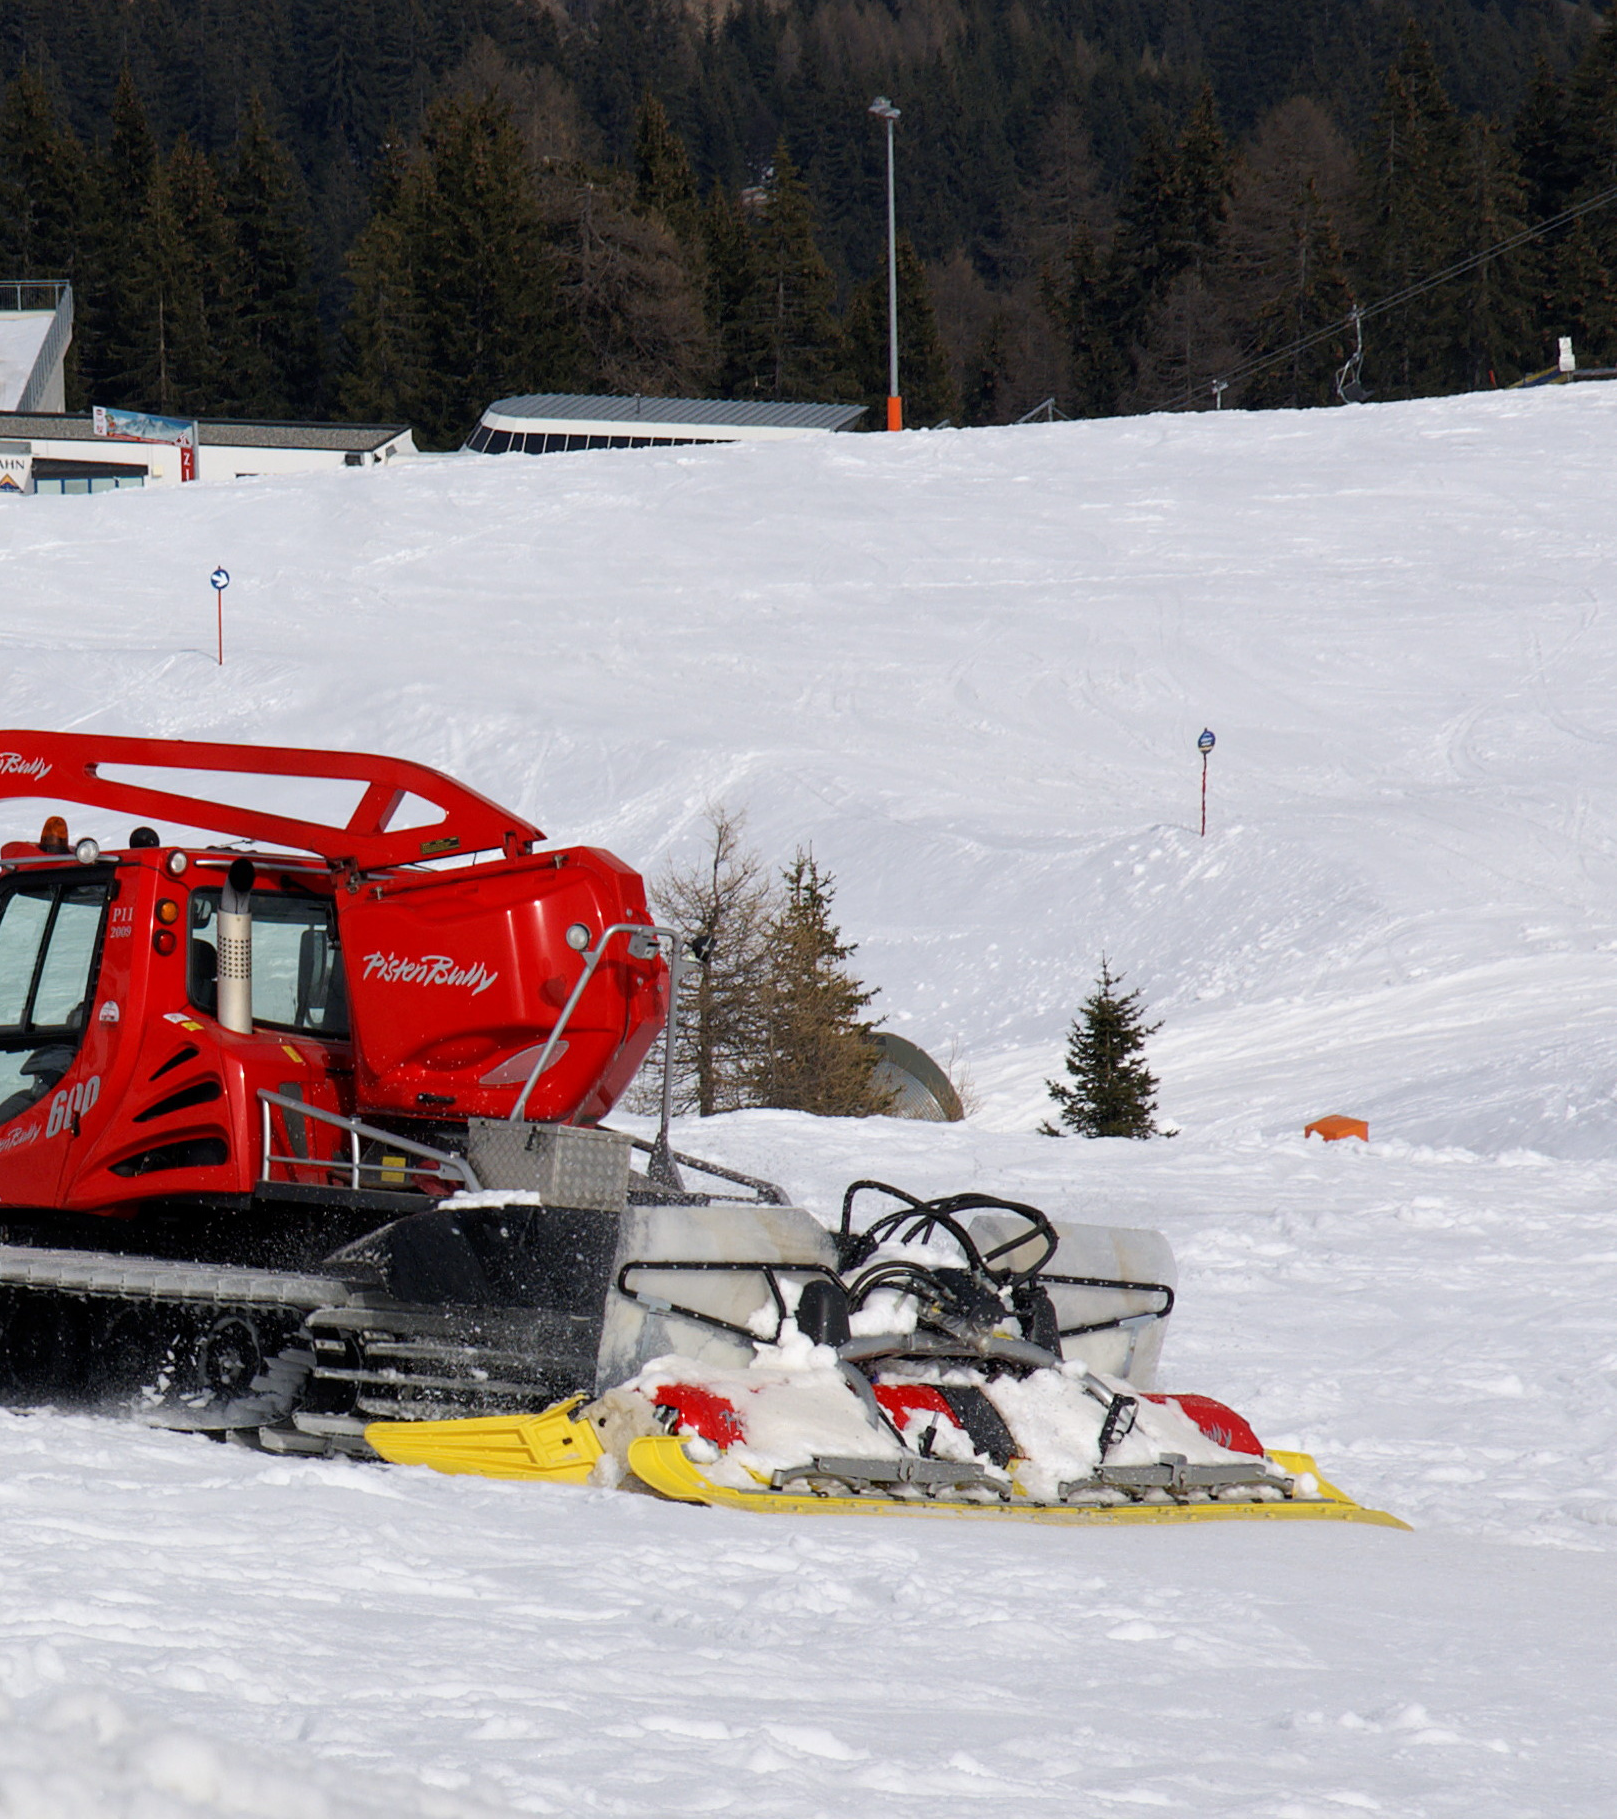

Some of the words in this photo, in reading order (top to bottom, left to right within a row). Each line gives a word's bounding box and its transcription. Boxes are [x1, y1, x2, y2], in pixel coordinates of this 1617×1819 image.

[112, 907, 133, 922] P11
[110, 926, 132, 938] 2009
[362, 950, 498, 997] PistenBully
[45, 1075, 101, 1139] 600
